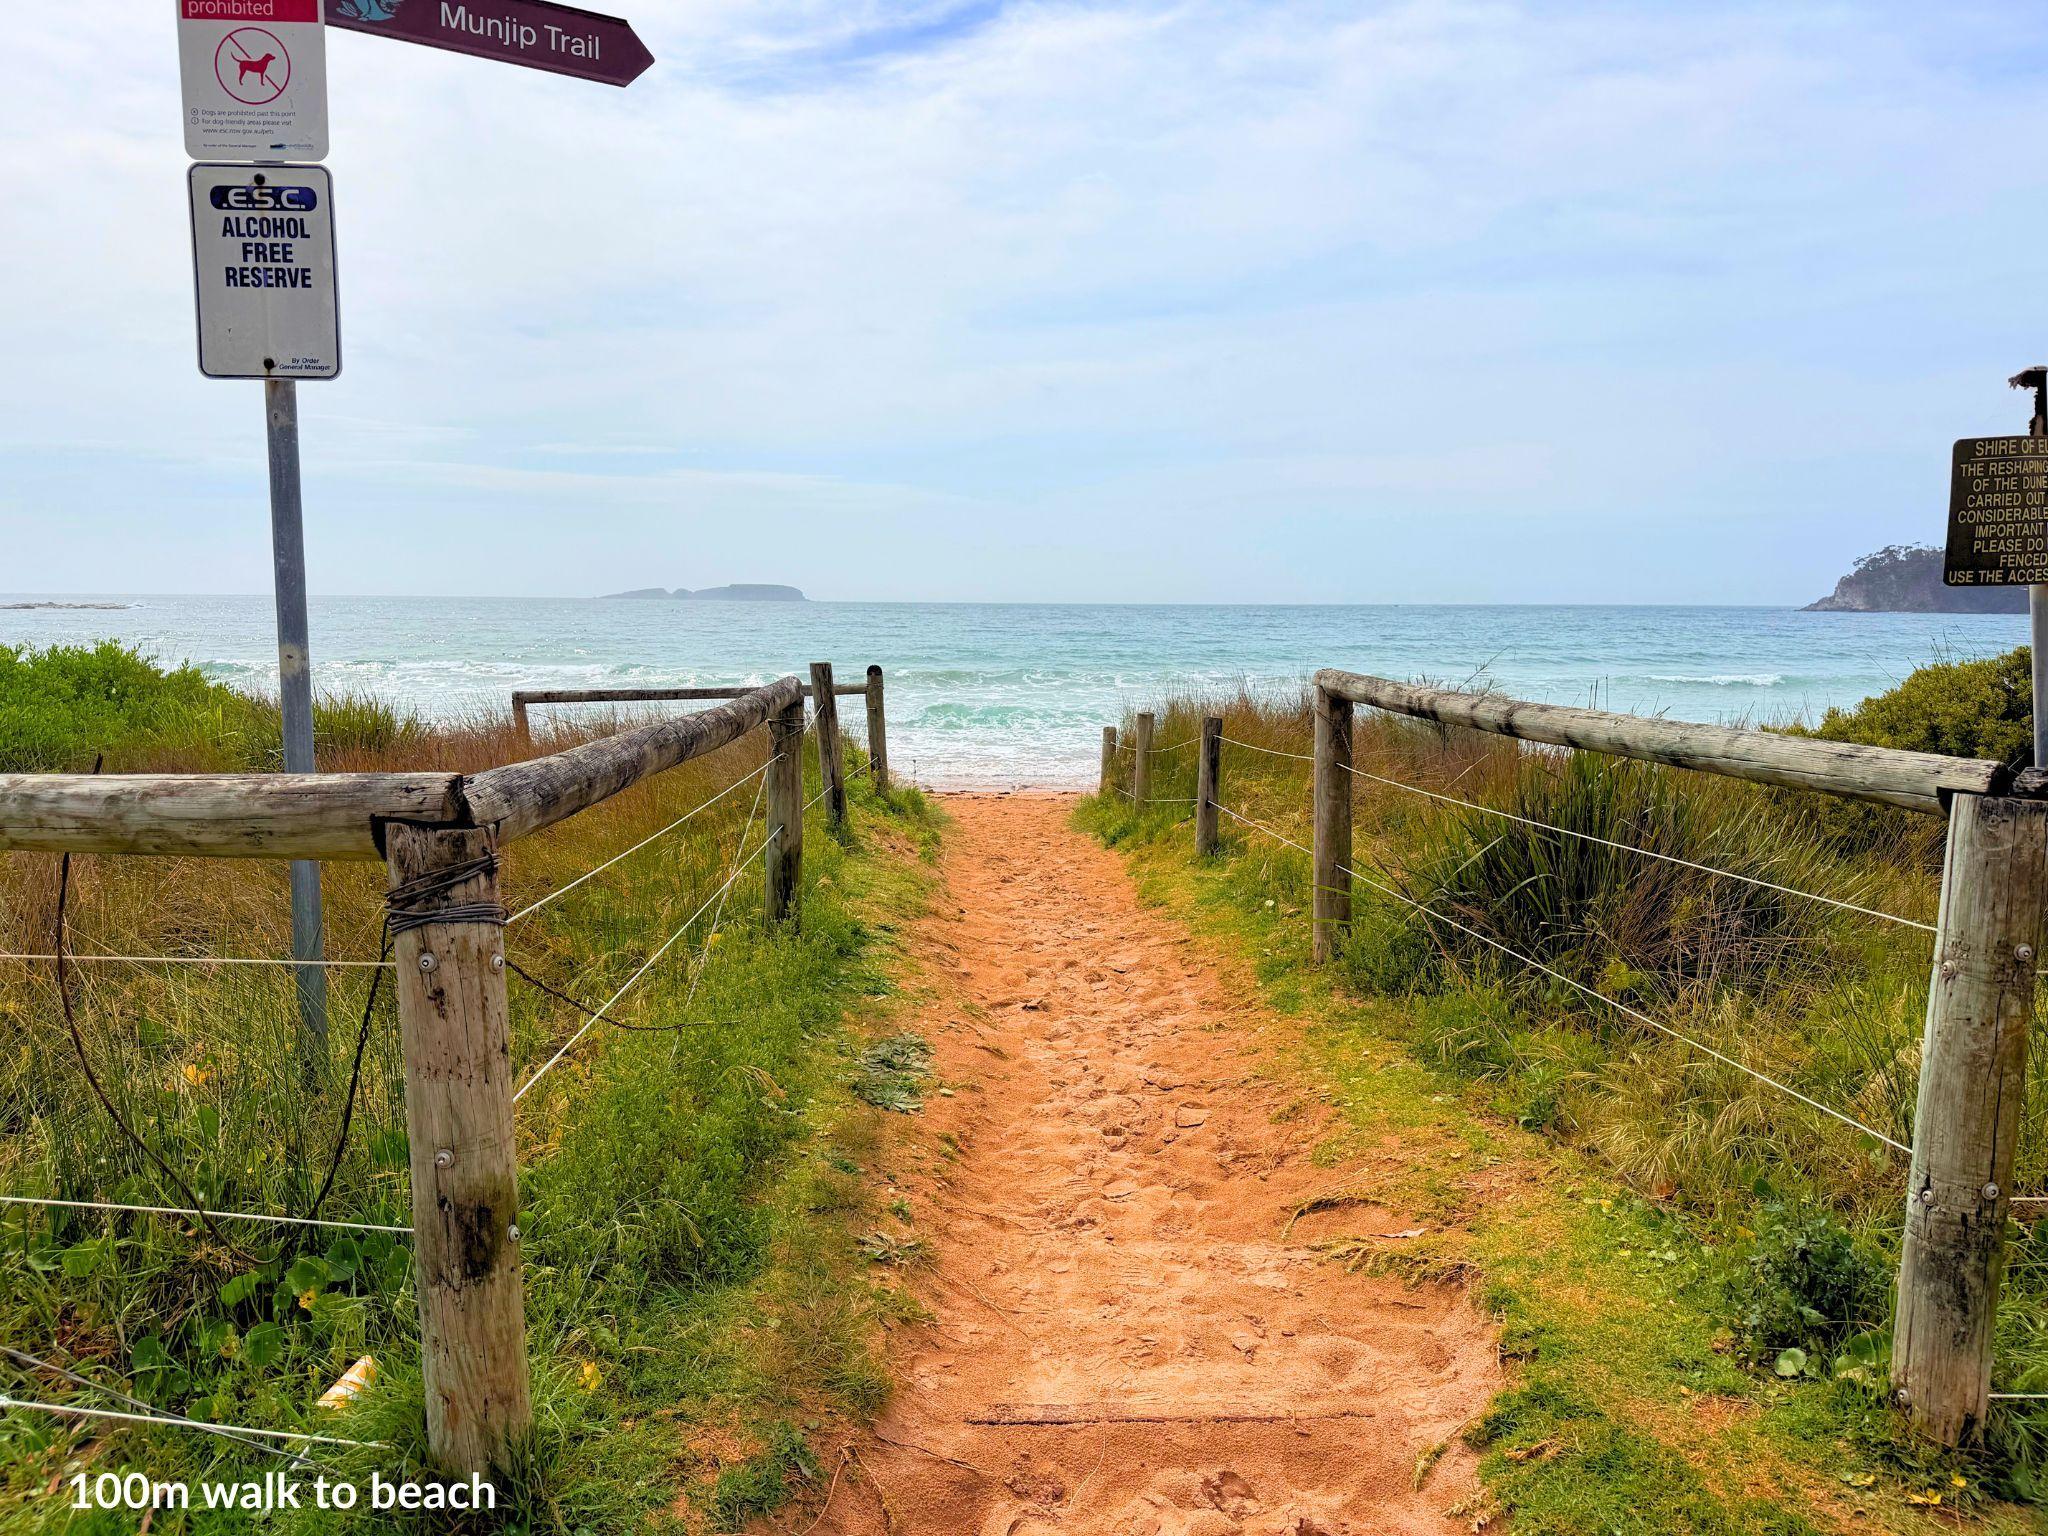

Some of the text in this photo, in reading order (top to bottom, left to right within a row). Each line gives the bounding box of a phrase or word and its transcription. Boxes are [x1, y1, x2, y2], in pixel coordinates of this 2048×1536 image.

[188, 0, 274, 16] prohibited
[440, 2, 600, 60] Munjip Trail
[201, 109, 216, 117] Dogs
[222, 216, 311, 239] ALCOHOL
[242, 242, 294, 263] FREE
[225, 266, 312, 288] RESERVE
[304, 364, 331, 372] Manager
[1975, 440, 2017, 456] SHIRE
[2021, 439, 2035, 454] OF
[1960, 460, 2048, 477] THE RESHAPING
[1972, 479, 1990, 492] OF
[1994, 477, 2018, 491] THE
[1967, 492, 2046, 508] CARRIED OUT
[1957, 507, 2048, 523] CONSIDERABLE
[1975, 523, 2044, 538] IMPORTANT
[1973, 538, 2044, 553] PLEASE DO
[1999, 553, 2048, 567] FENCED
[1948, 568, 2048, 583] USE THE ACCES
